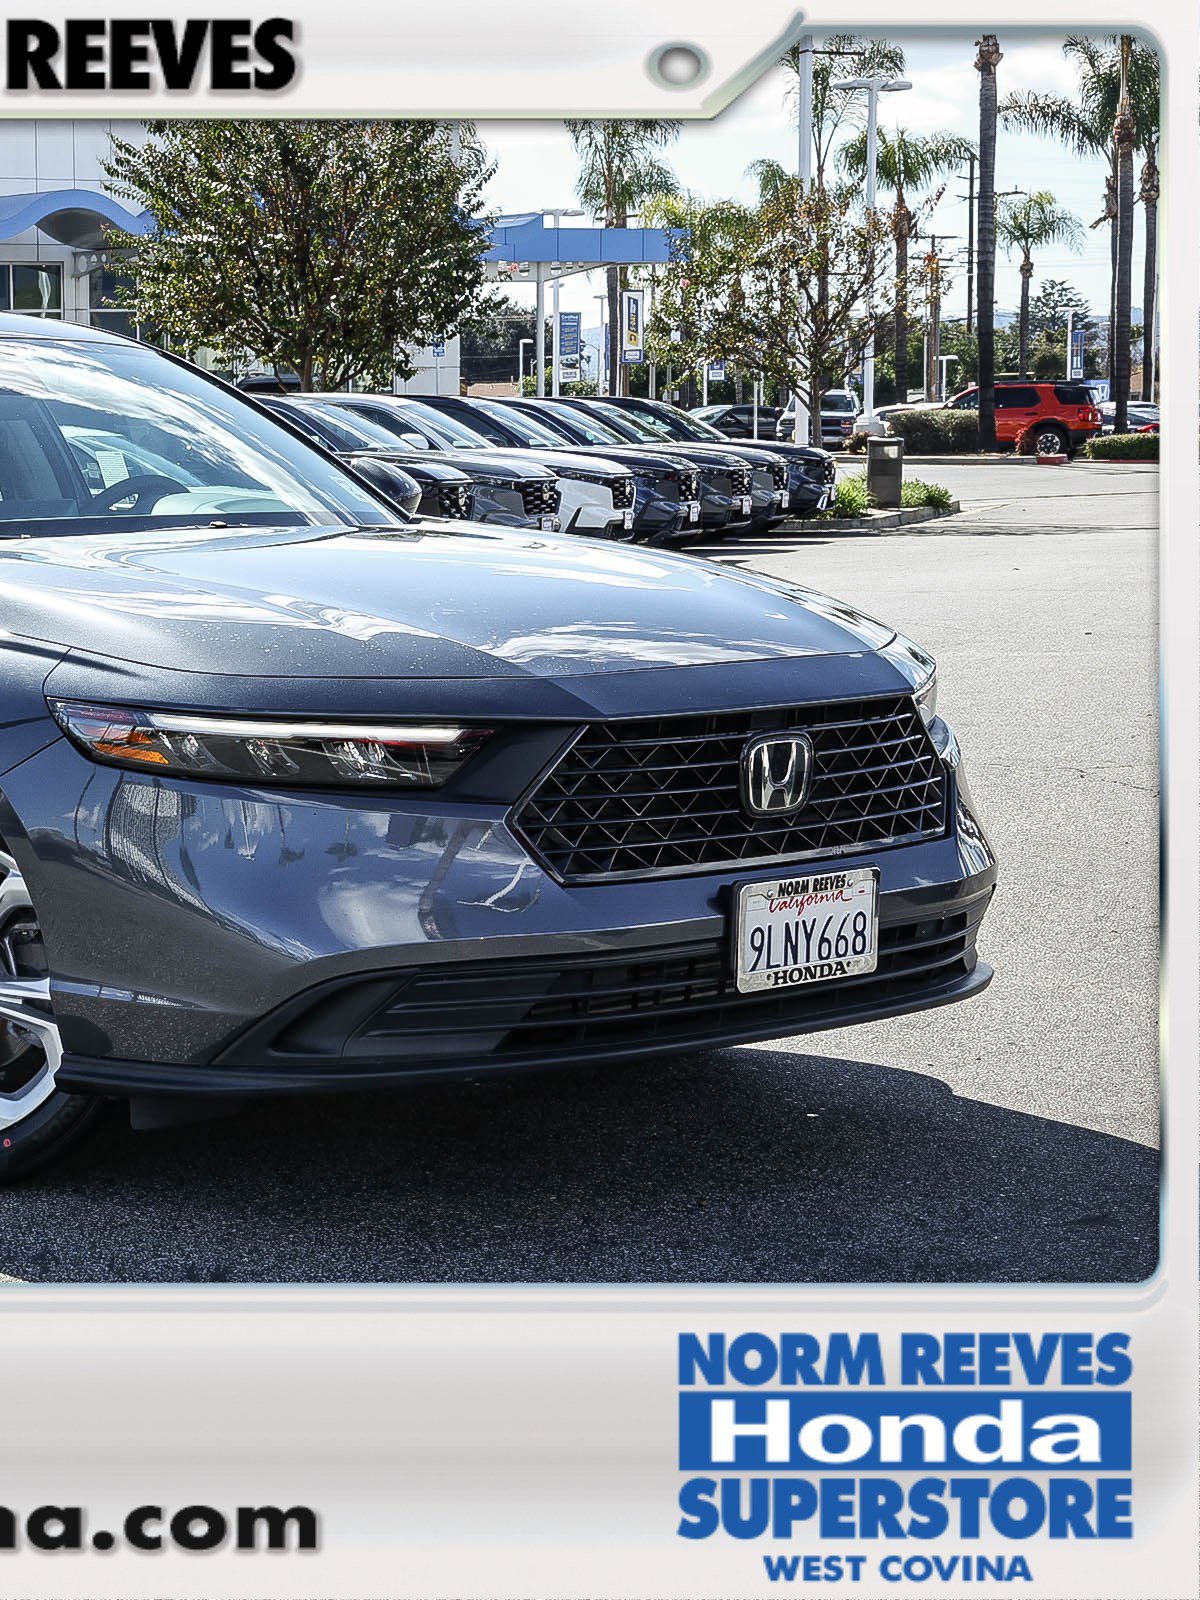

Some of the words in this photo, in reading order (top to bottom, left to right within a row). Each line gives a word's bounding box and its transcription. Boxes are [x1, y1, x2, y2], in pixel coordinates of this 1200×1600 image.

[778, 880, 810, 898] NORM
[813, 874, 846, 891] REEVES
[768, 889, 853, 916] California
[749, 910, 867, 972] 9LNY668
[771, 961, 848, 987] HONDA
